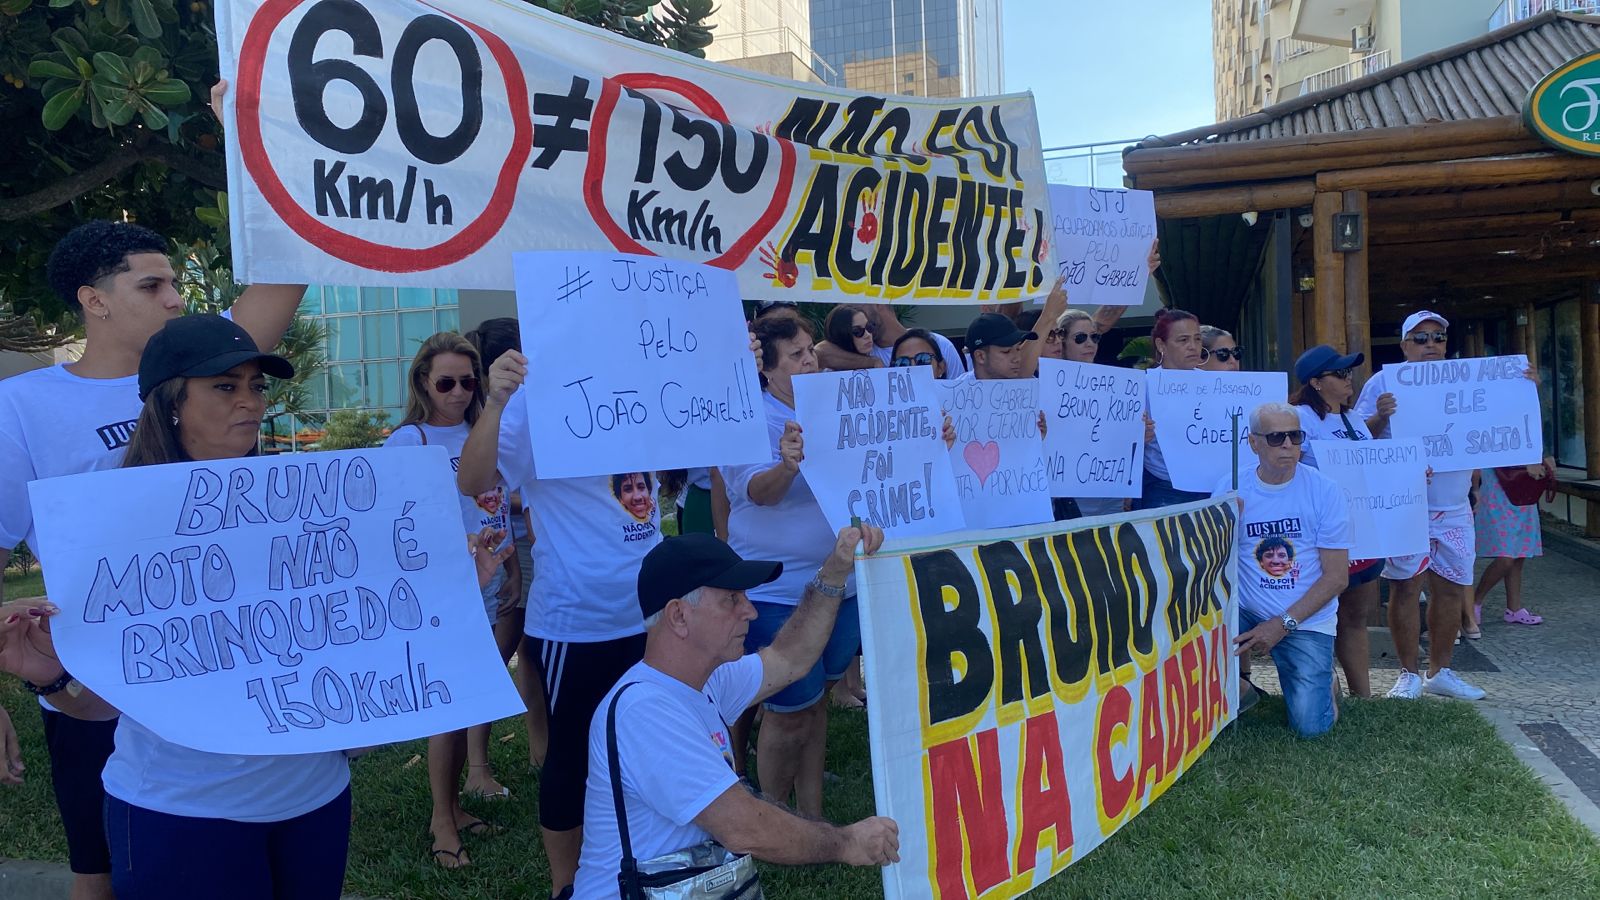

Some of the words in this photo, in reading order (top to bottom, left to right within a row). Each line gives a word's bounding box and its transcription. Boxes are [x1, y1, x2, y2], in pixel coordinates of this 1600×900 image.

[287, 0, 483, 164] 60
[622, 86, 770, 194] 150
[313, 158, 453, 226] Km/h
[1088, 187, 1128, 214] STJ
[627, 189, 723, 255] Km/h
[781, 162, 1045, 293] ACIDENTE!
[1083, 240, 1121, 264] PELO
[610, 259, 709, 299] JUSTIÇA
[1058, 260, 1086, 286] OÃO
[1095, 263, 1140, 288] GABRIEL
[638, 317, 699, 360] PELO
[836, 370, 876, 412] NÃO
[887, 368, 917, 406] FOI
[1075, 366, 1116, 394] LUGAR
[1124, 379, 1139, 397] DO
[1157, 372, 1189, 396] LUGAR
[1397, 361, 1471, 387] CUIDADO
[562, 375, 648, 439] JOÃO
[941, 379, 984, 413] JOÃO
[1106, 398, 1142, 422] KRUPP
[1193, 402, 1203, 421] É
[1224, 405, 1244, 420] NA
[1444, 388, 1488, 415] ELE
[987, 410, 1038, 440] ETERNO
[1186, 424, 1249, 446] CADEA
[861, 445, 894, 485] FOI
[1012, 456, 1049, 495] VOCÊ
[1076, 442, 1138, 487] CADEIA!
[1343, 445, 1418, 466] INSTAGRAM
[175, 456, 377, 536] BRUNO
[83, 542, 236, 623] MOTO
[269, 517, 359, 591] NÃO
[393, 501, 429, 572] É
[122, 577, 440, 684] BRINQUEDO.
[911, 521, 1158, 726] BRUNO
[928, 709, 1074, 900] NA
[1096, 622, 1229, 819] CADEIA!
